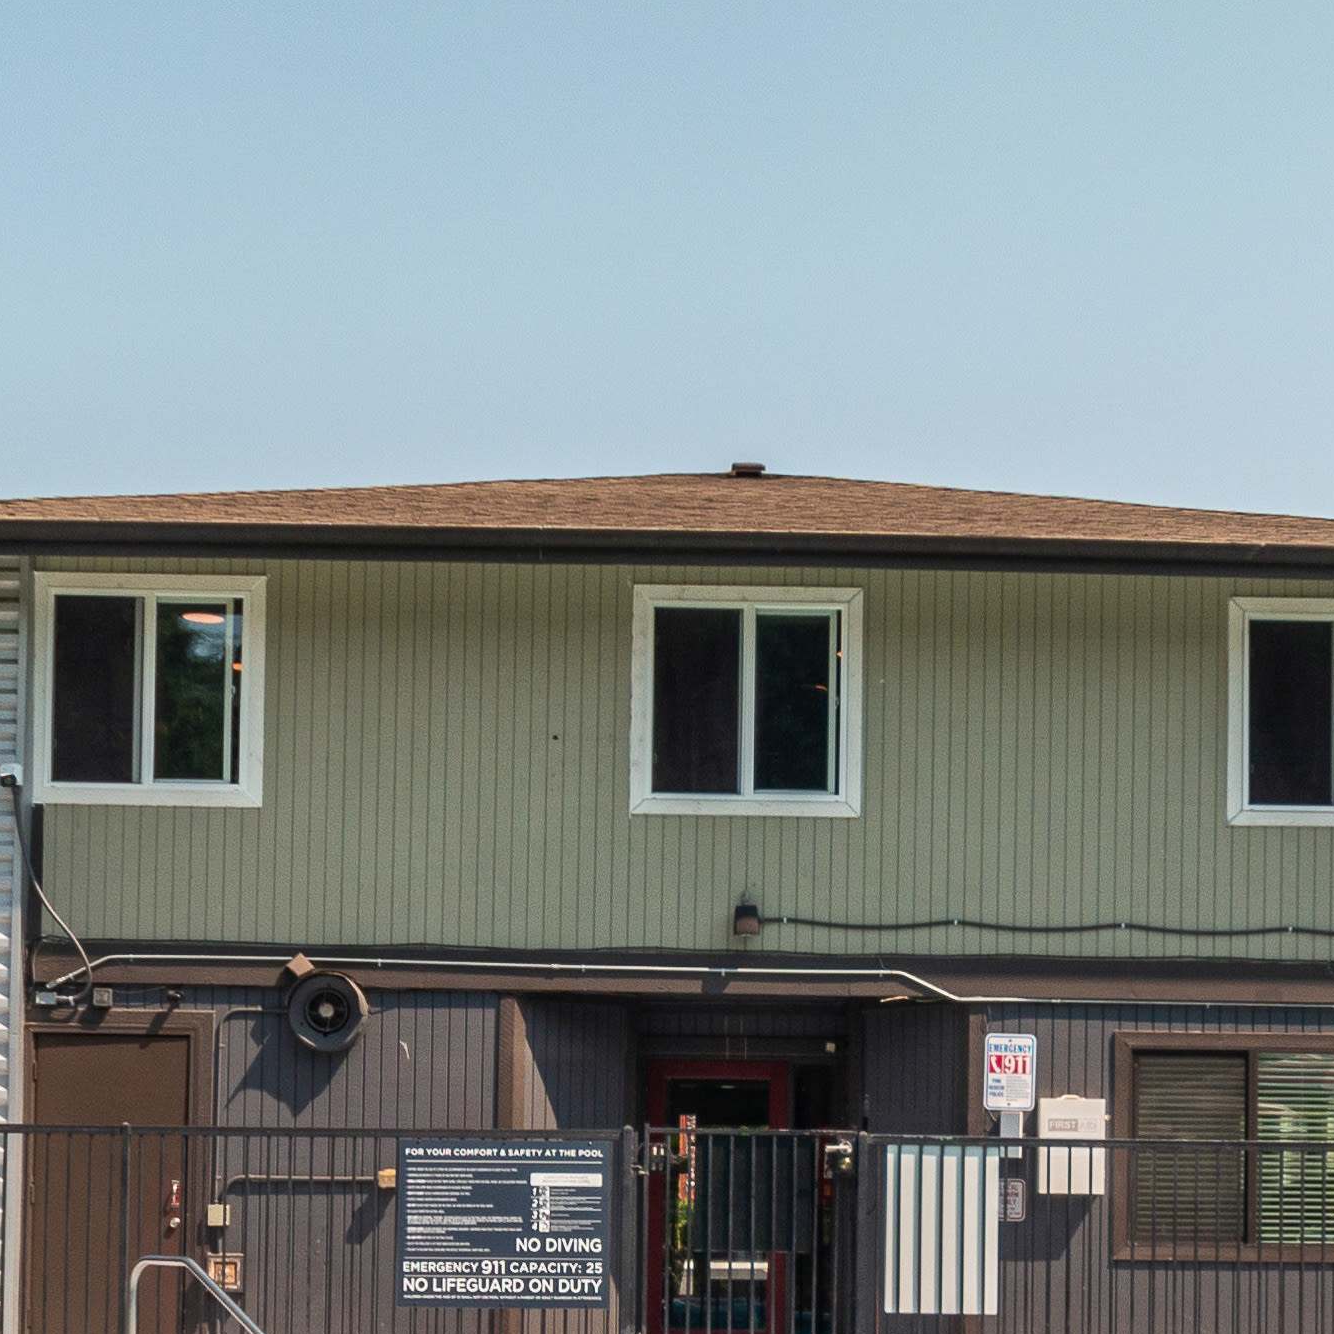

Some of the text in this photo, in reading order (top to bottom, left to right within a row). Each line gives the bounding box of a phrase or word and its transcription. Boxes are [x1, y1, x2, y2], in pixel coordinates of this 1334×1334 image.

[988, 1043, 1031, 1053] EMERGENCY
[1004, 1054, 1031, 1074] 911
[1049, 1120, 1077, 1131] FIRST
[405, 1148, 424, 1156] FOR
[426, 1148, 451, 1156] YOUR
[454, 1148, 498, 1156] COMFORT
[508, 1149, 542, 1157] SAFETY
[545, 1149, 557, 1157] AT
[559, 1149, 576, 1157] THE
[578, 1149, 603, 1158] POOL
[532, 1187, 537, 1196] 1
[531, 1199, 538, 1207] 2
[531, 1210, 538, 1219] 3
[516, 1238, 602, 1253] NO DIVING
[402, 1259, 603, 1275] EMERGENCY 911 CAPACITY: 25
[403, 1277, 602, 1294] NO LIFEGUARD ON DUTY
